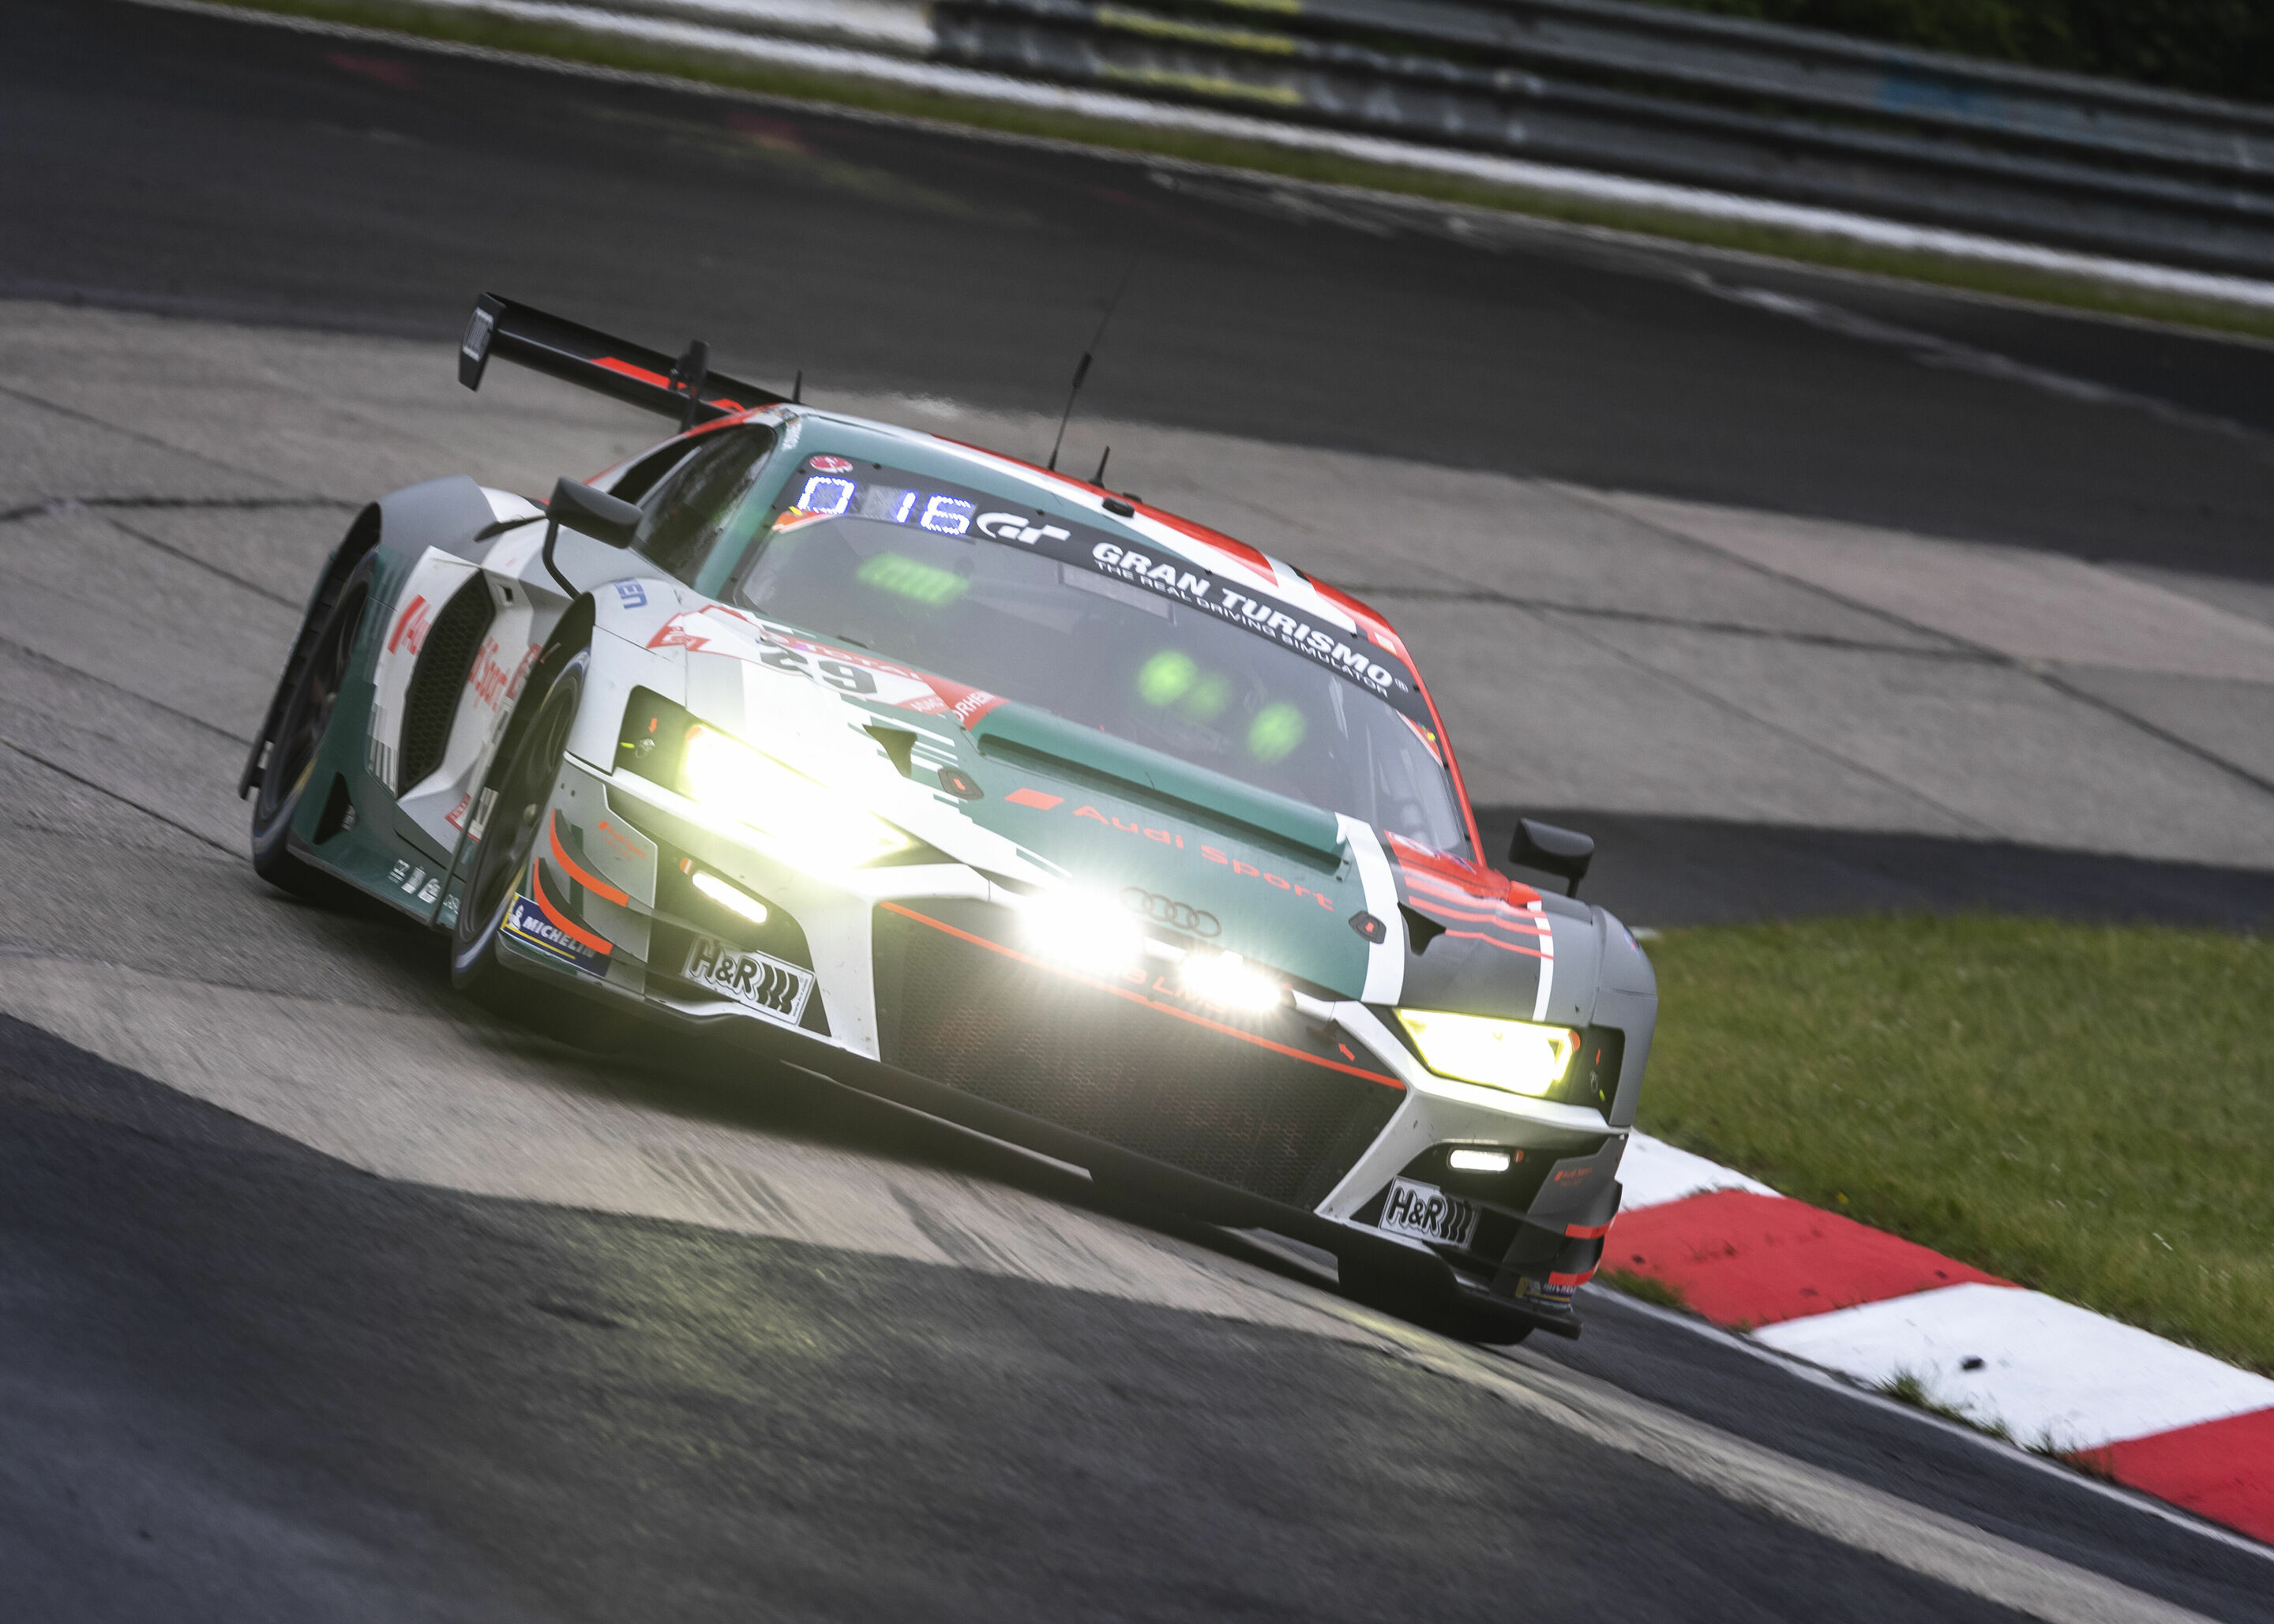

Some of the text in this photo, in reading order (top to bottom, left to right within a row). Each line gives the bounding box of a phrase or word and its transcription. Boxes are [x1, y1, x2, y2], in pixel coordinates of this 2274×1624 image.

[1093, 542, 1393, 687] GRAN TURISMO
[1094, 559, 1388, 698] THE REAL DRIVING SIMULATOR
[1073, 805, 1334, 911] Audi Sport
[523, 915, 596, 958] MICHELIN
[690, 938, 759, 992] H&R
[1387, 1186, 1443, 1232] H&R
